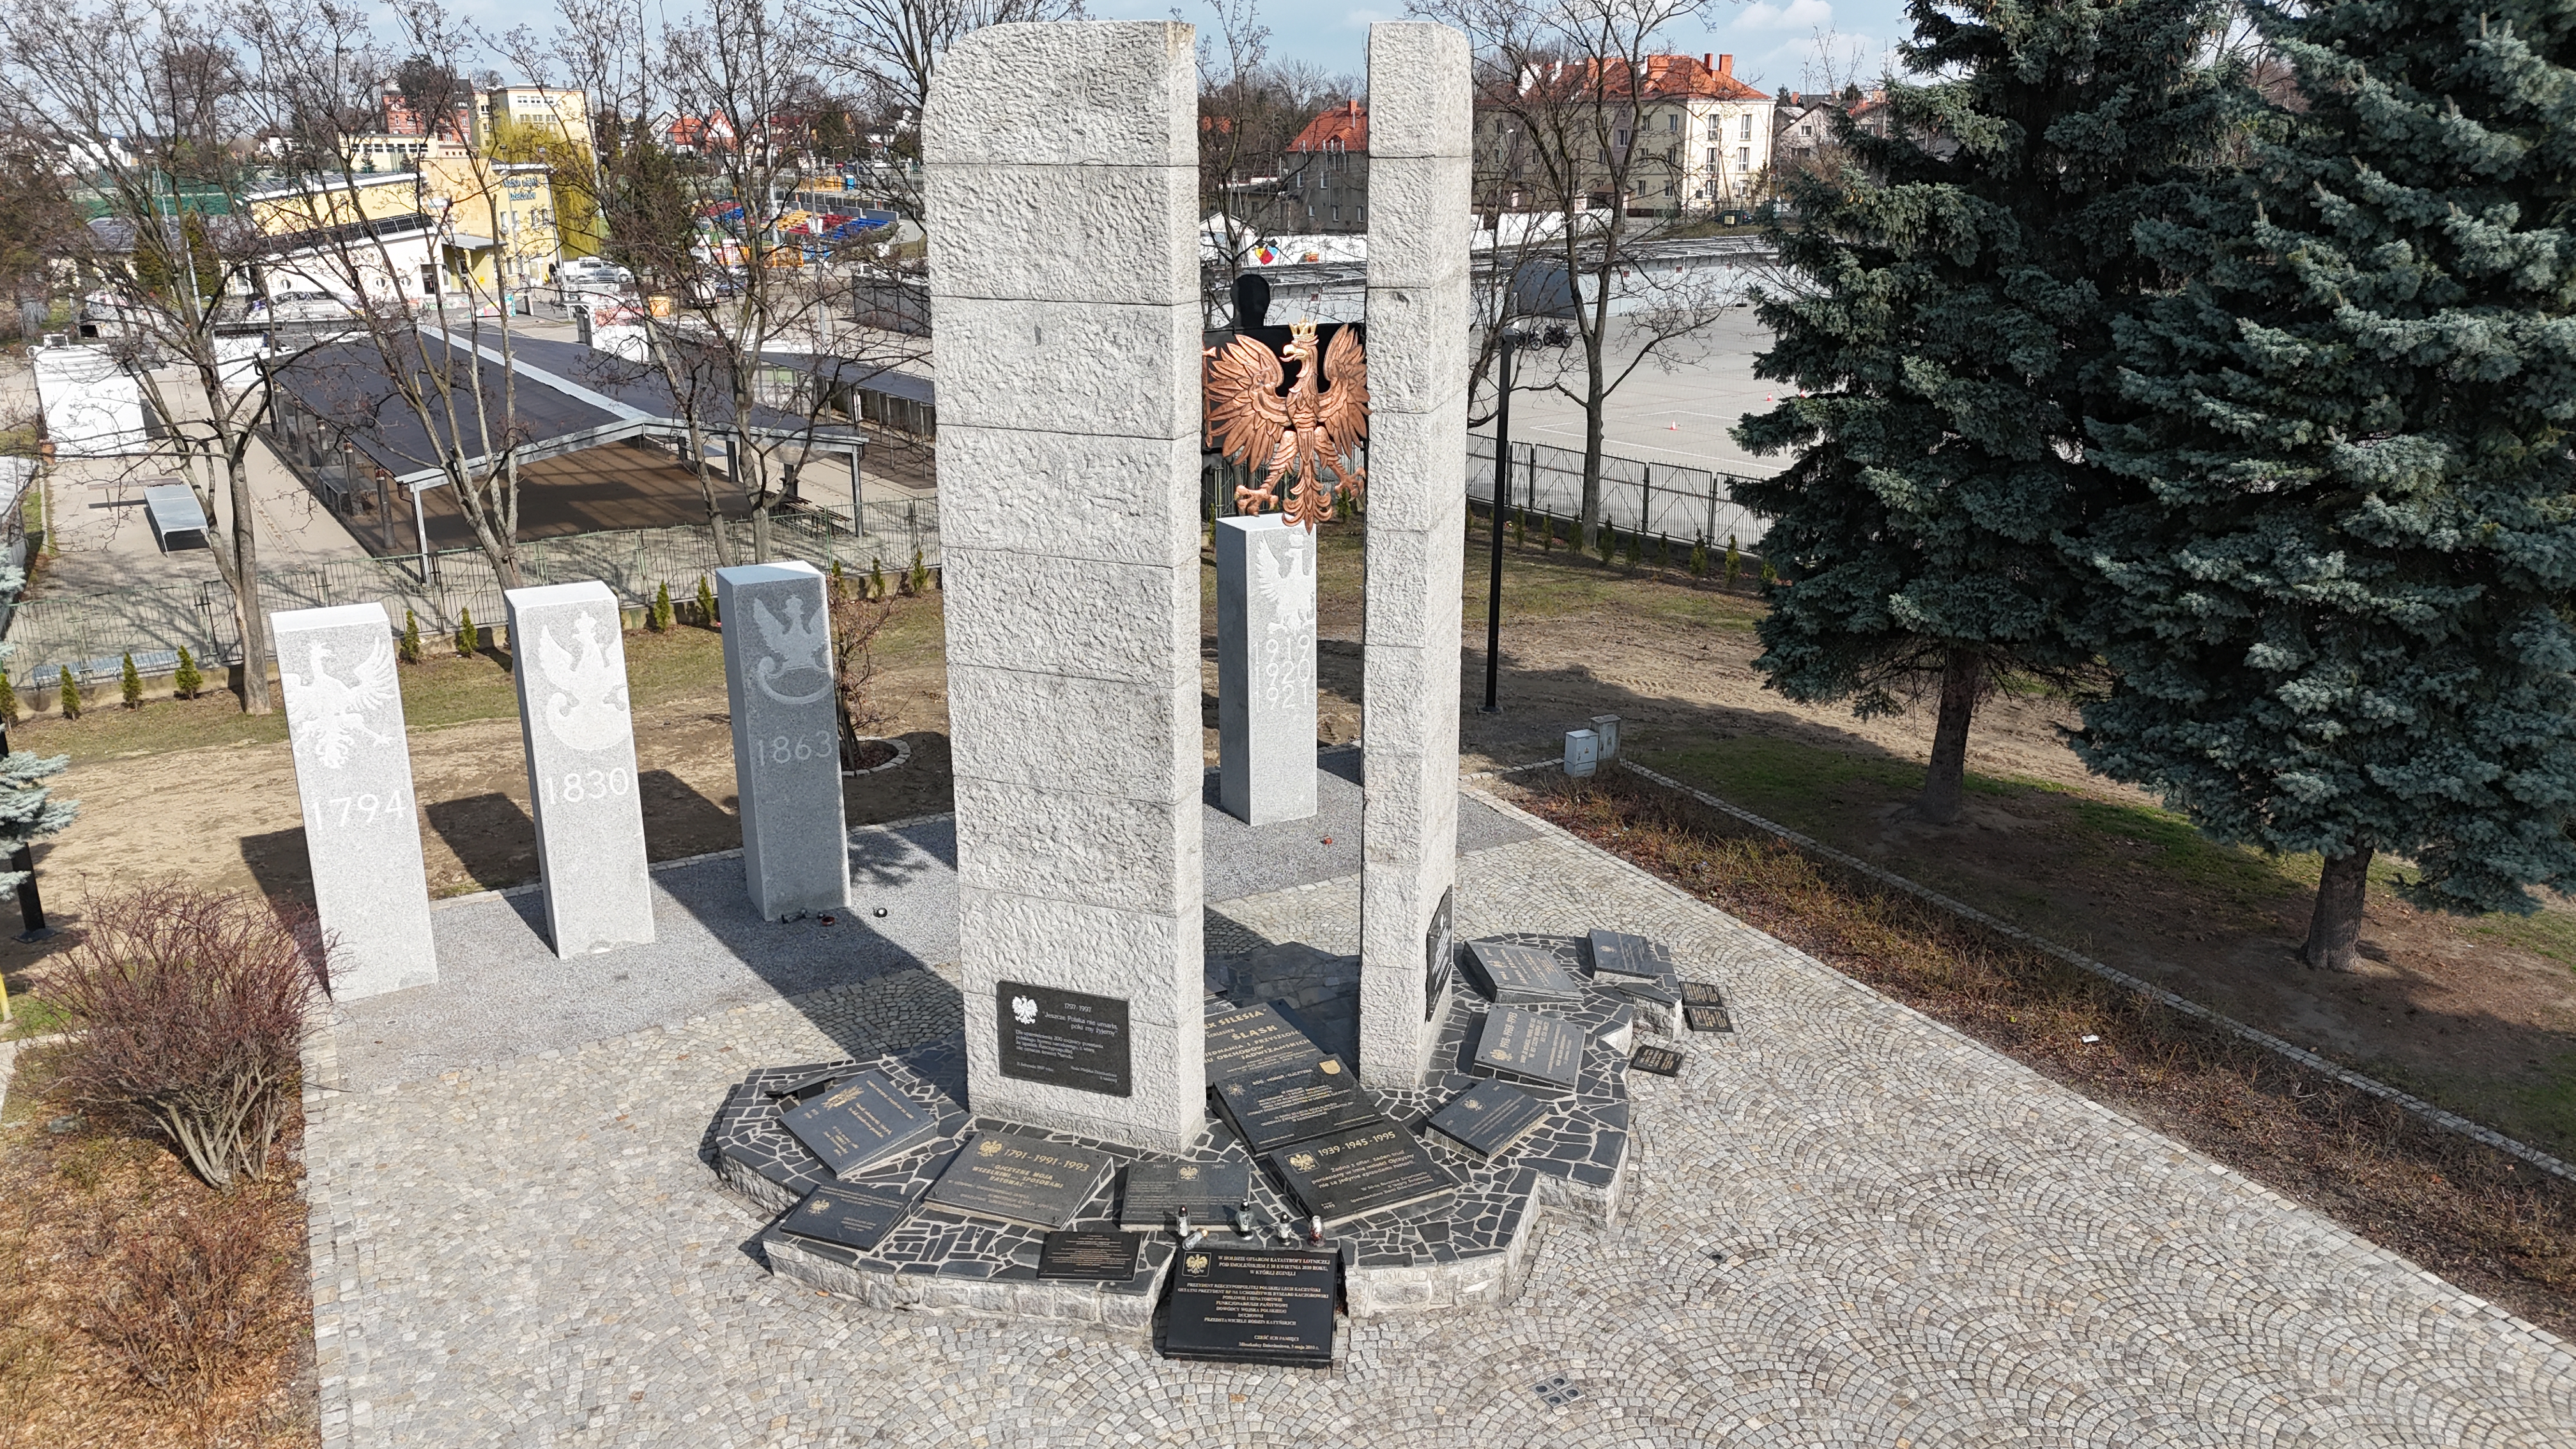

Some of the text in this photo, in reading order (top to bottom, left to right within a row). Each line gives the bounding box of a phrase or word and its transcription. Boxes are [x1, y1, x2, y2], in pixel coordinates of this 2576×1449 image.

[1253, 634, 1310, 664] 1919
[1254, 658, 1311, 688] 1920
[1255, 684, 1308, 712] 1921
[757, 730, 833, 767] 1863
[545, 767, 630, 806] 1830
[311, 790, 406, 831] 1794
[1232, 1025, 1278, 1040] ŚLĄSK
[1288, 1068, 1313, 1077] OJCZYZNA
[1318, 1146, 1340, 1157] 1939
[1345, 1138, 1368, 1149] 1945
[1372, 1131, 1396, 1143] 1995
[1004, 1149, 1028, 1160] 1791
[1034, 1154, 1058, 1166] 1991
[1063, 1160, 1090, 1172] 1993
[1388, 1154, 1414, 1163] Ojczyzny
[1022, 1177, 1064, 1188] SPOSOBAMI
[1338, 1174, 1361, 1184] jedynie
[1362, 1166, 1392, 1177] epizodami
